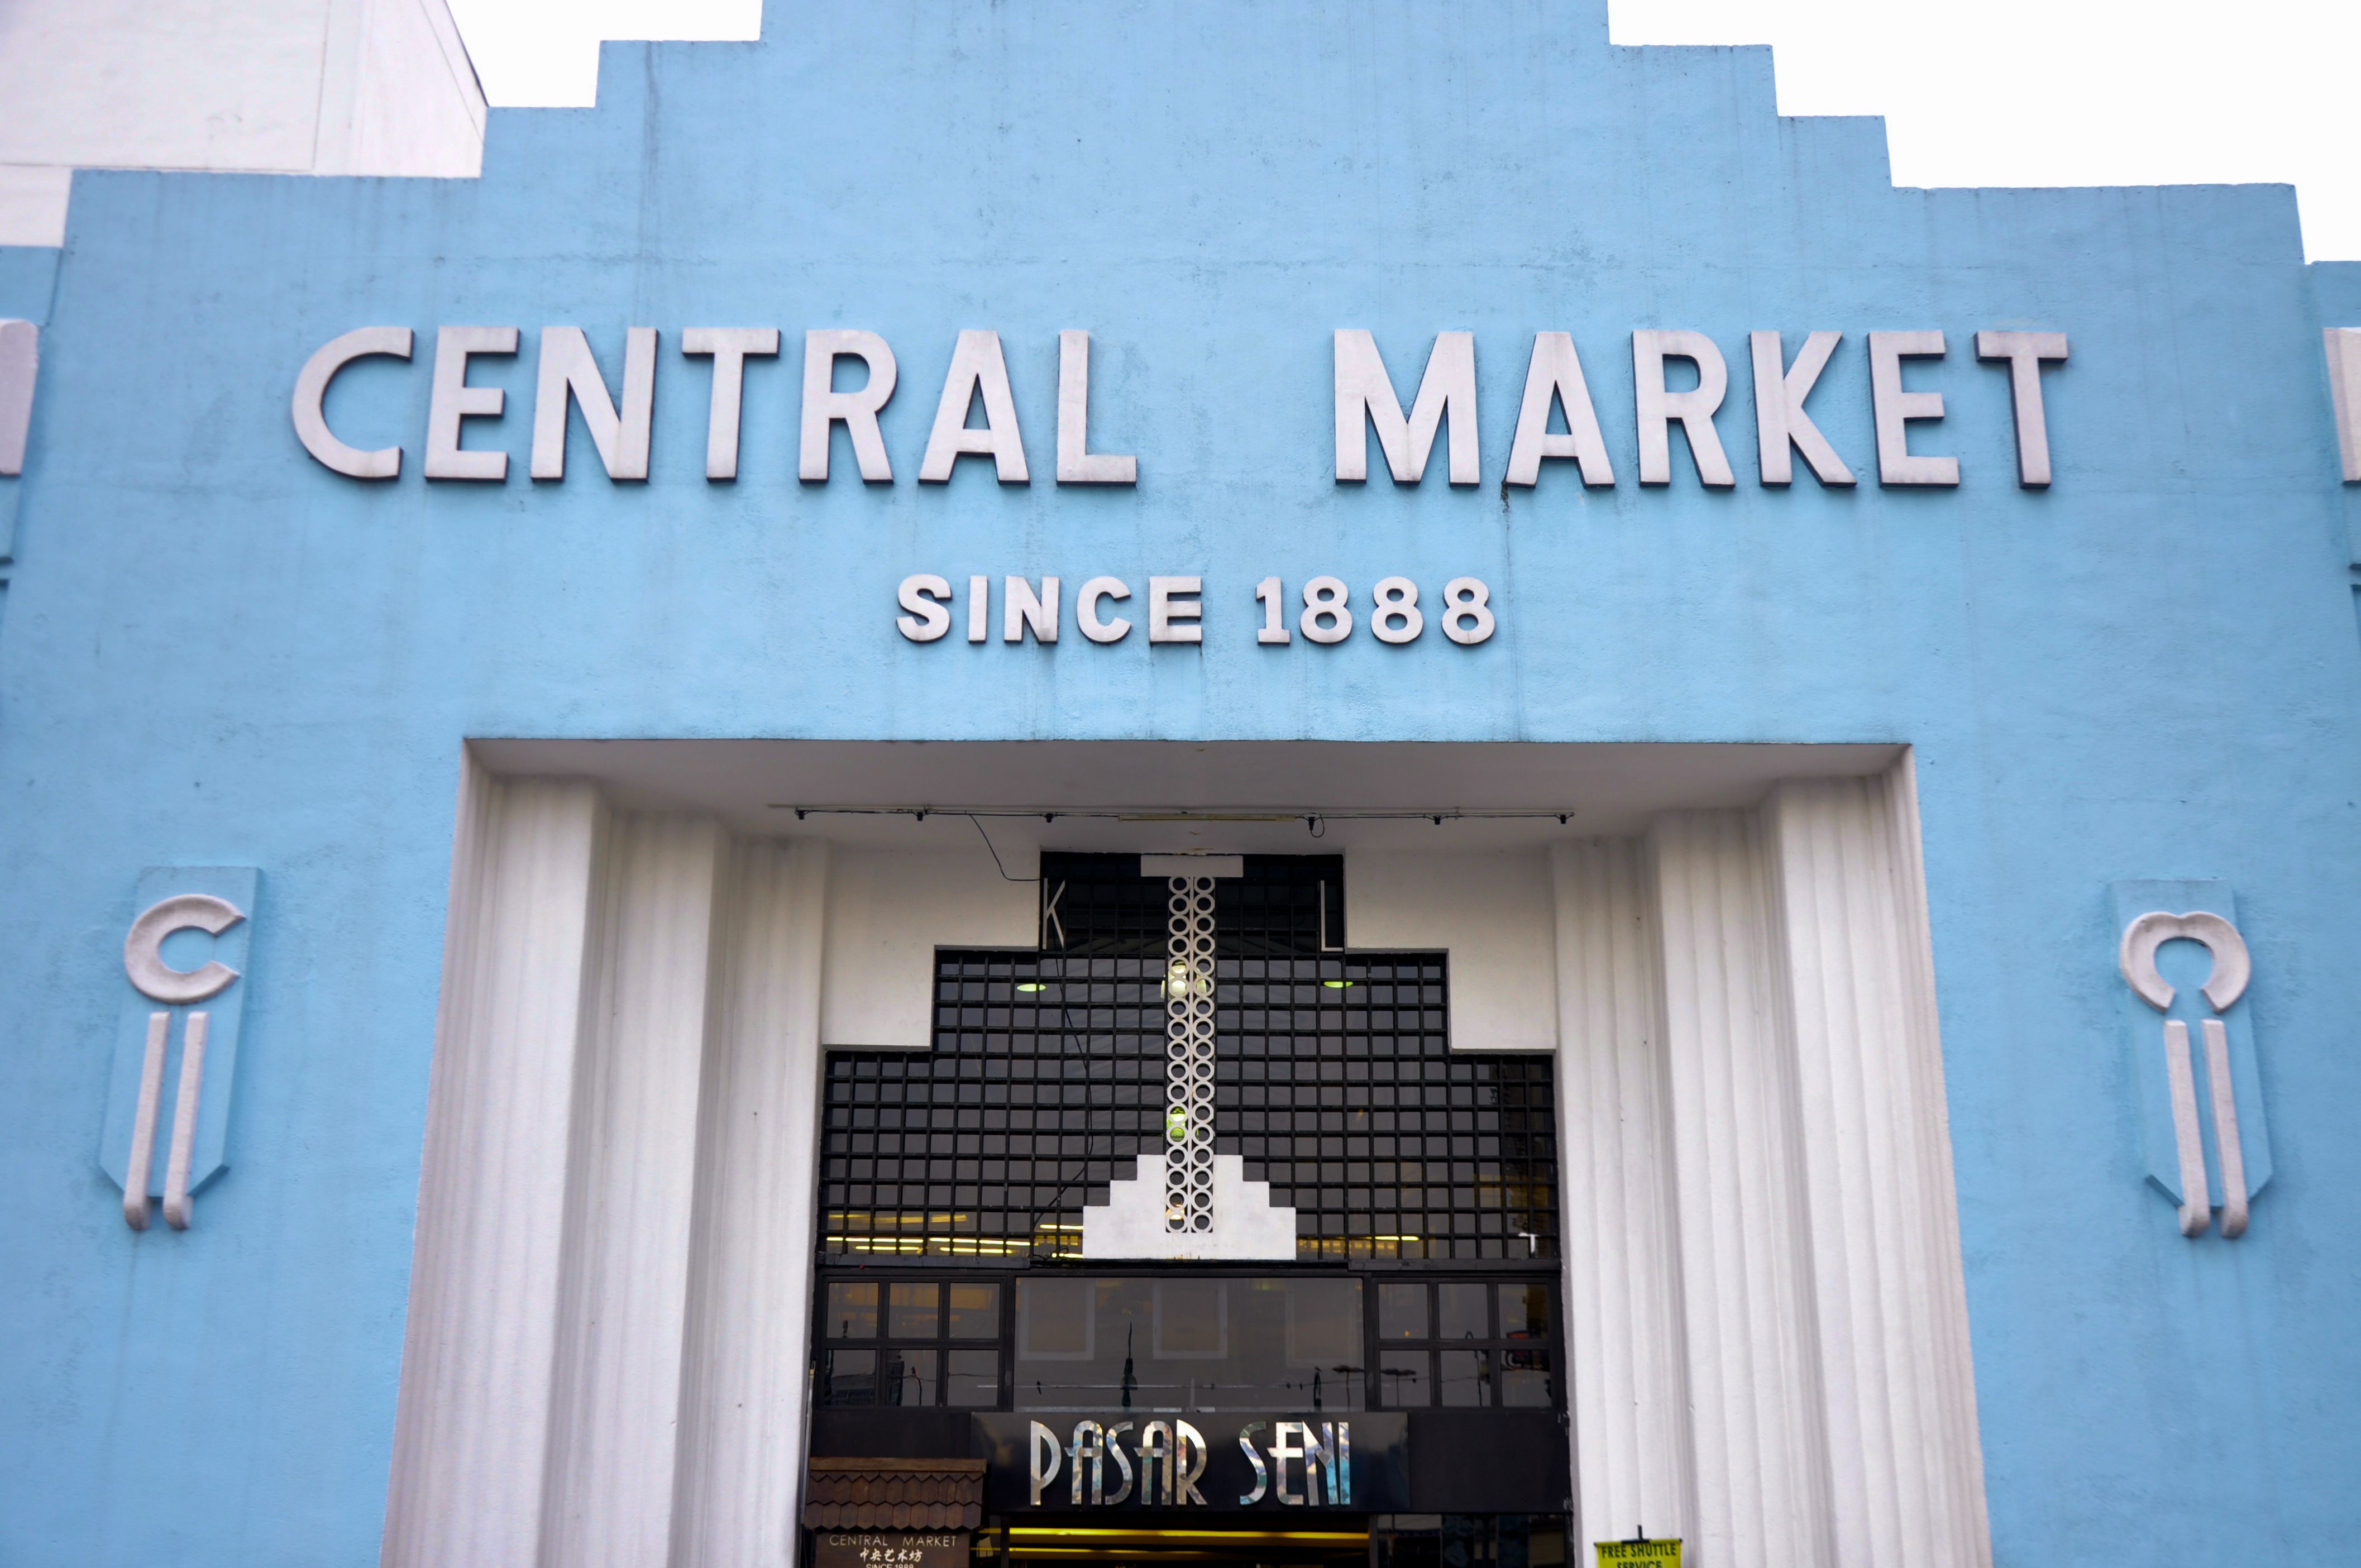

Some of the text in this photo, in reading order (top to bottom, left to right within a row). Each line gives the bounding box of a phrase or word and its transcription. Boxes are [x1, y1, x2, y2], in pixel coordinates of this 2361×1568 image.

[291, 324, 2069, 490] CENTRAL MARKET
[895, 573, 1496, 646] SINCE 1888
[1030, 1419, 1351, 1507] PASAR SENI
[829, 1534, 957, 1547] CENTRAL MARKET
[859, 1547, 923, 1563] 中央艺术坊
[1602, 1542, 1676, 1559] FREE SHUTTLE
